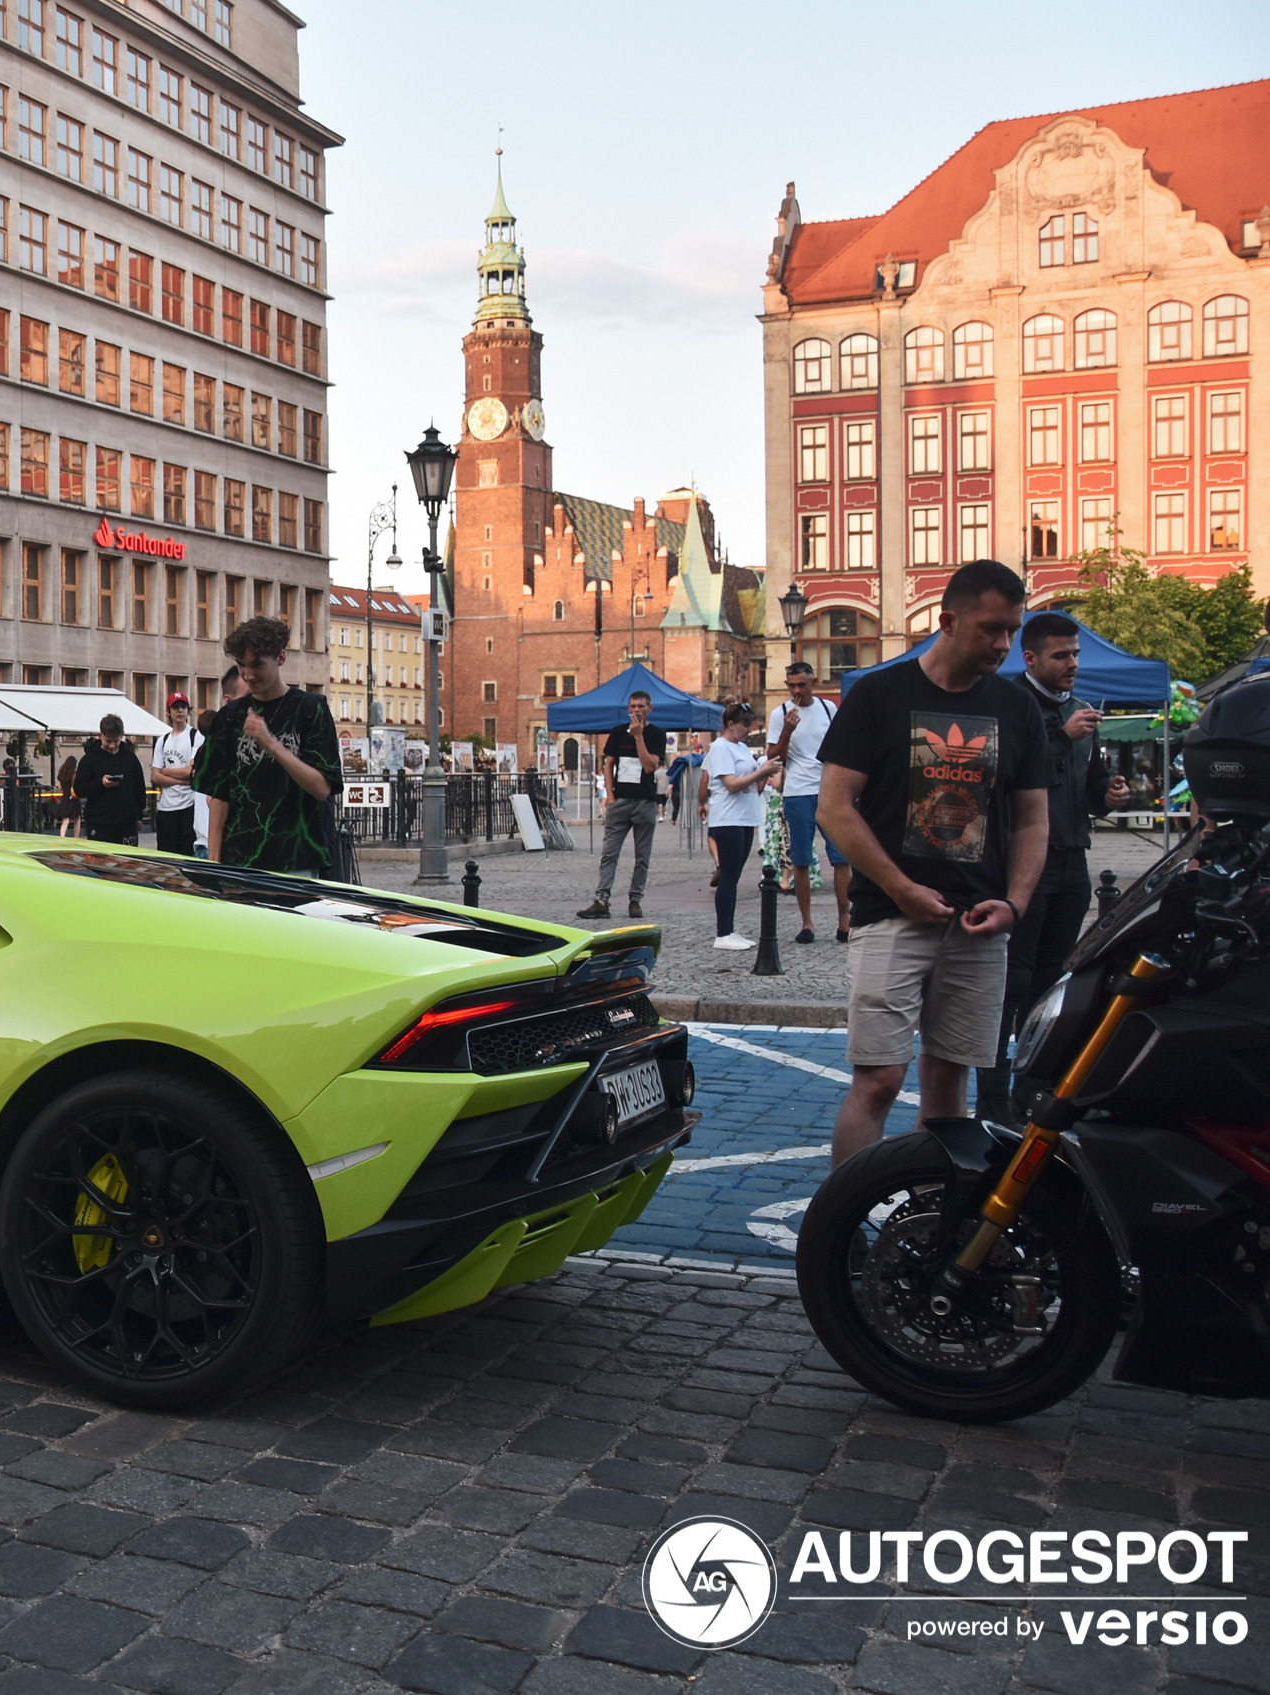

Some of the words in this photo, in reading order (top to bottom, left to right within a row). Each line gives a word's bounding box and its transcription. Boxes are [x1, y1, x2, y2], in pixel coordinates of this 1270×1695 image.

[115, 526, 187, 559] Santander
[923, 764, 983, 783] adidas
[1214, 764, 1239, 773] SHOEI
[348, 790, 364, 800] WC
